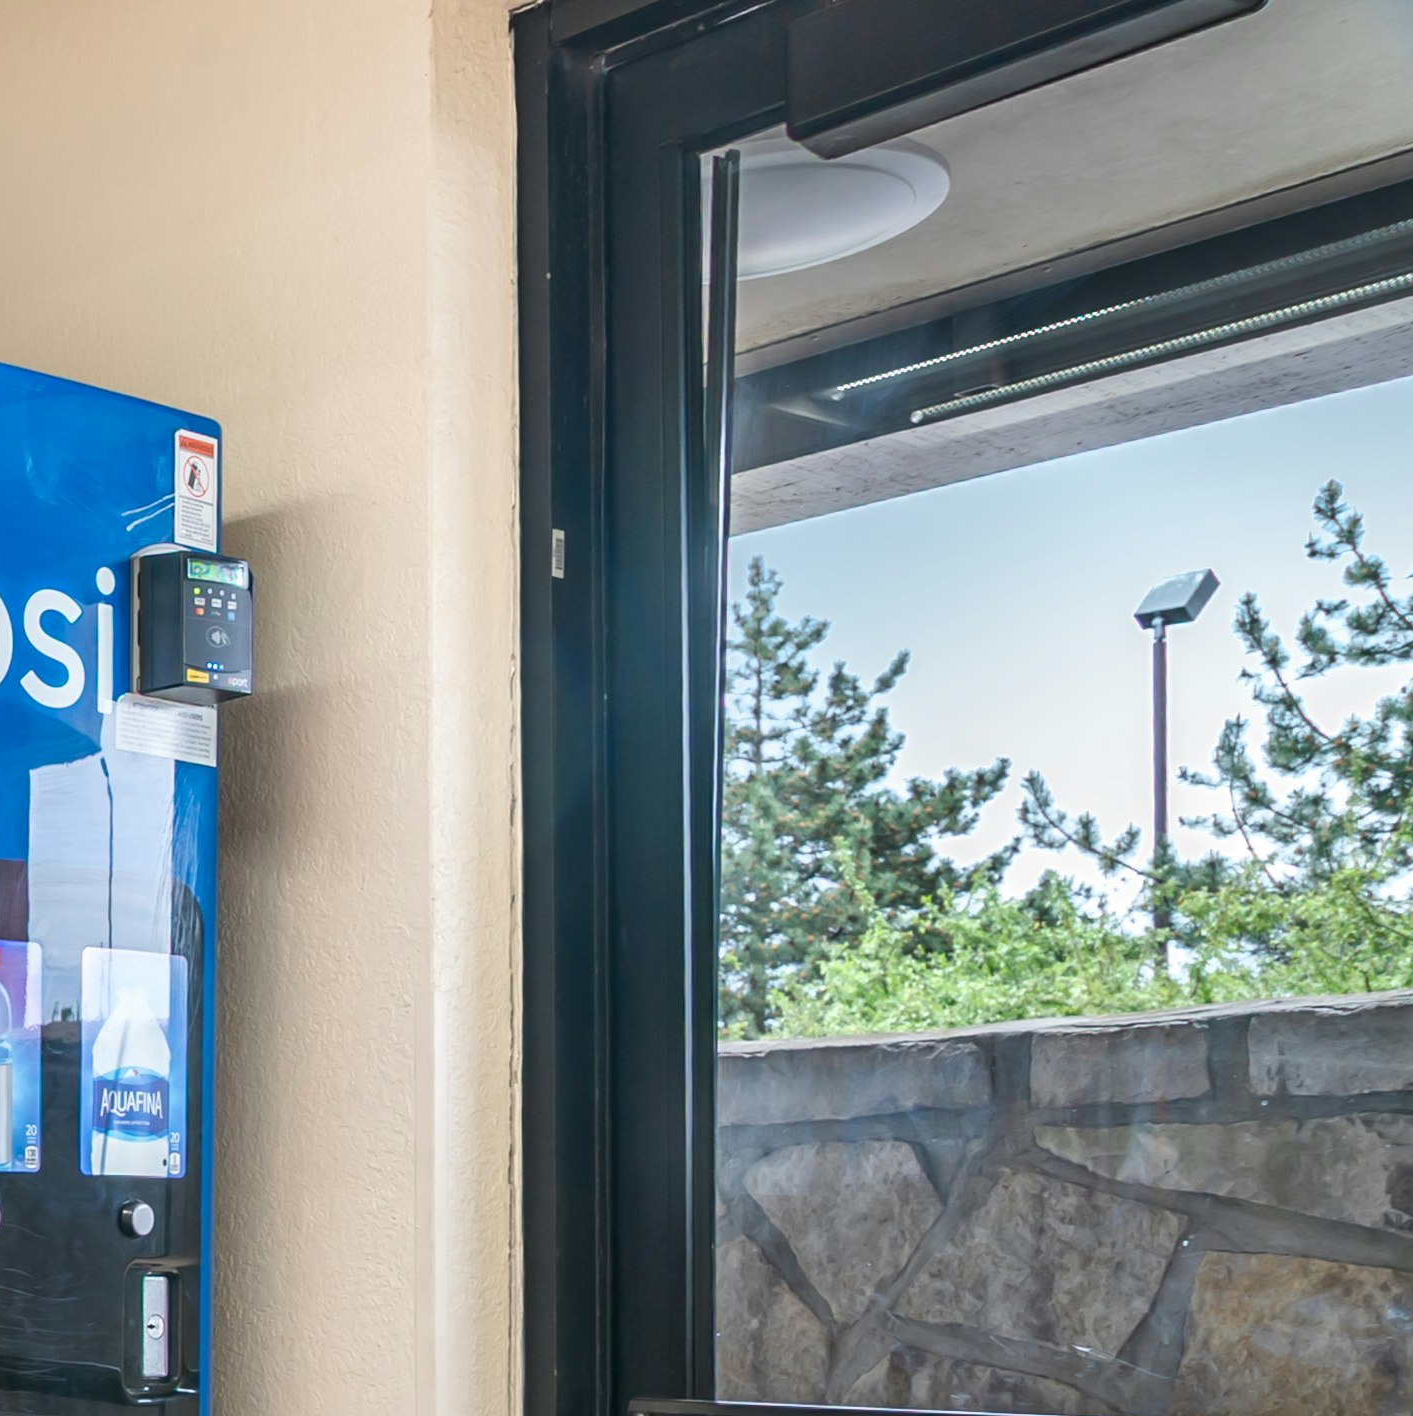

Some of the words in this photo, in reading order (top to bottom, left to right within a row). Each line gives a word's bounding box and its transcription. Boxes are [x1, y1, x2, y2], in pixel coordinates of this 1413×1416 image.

[100, 1088, 163, 1119] AQUAFINA
[25, 1124, 37, 1136] 20
[170, 1132, 181, 1144] 20
